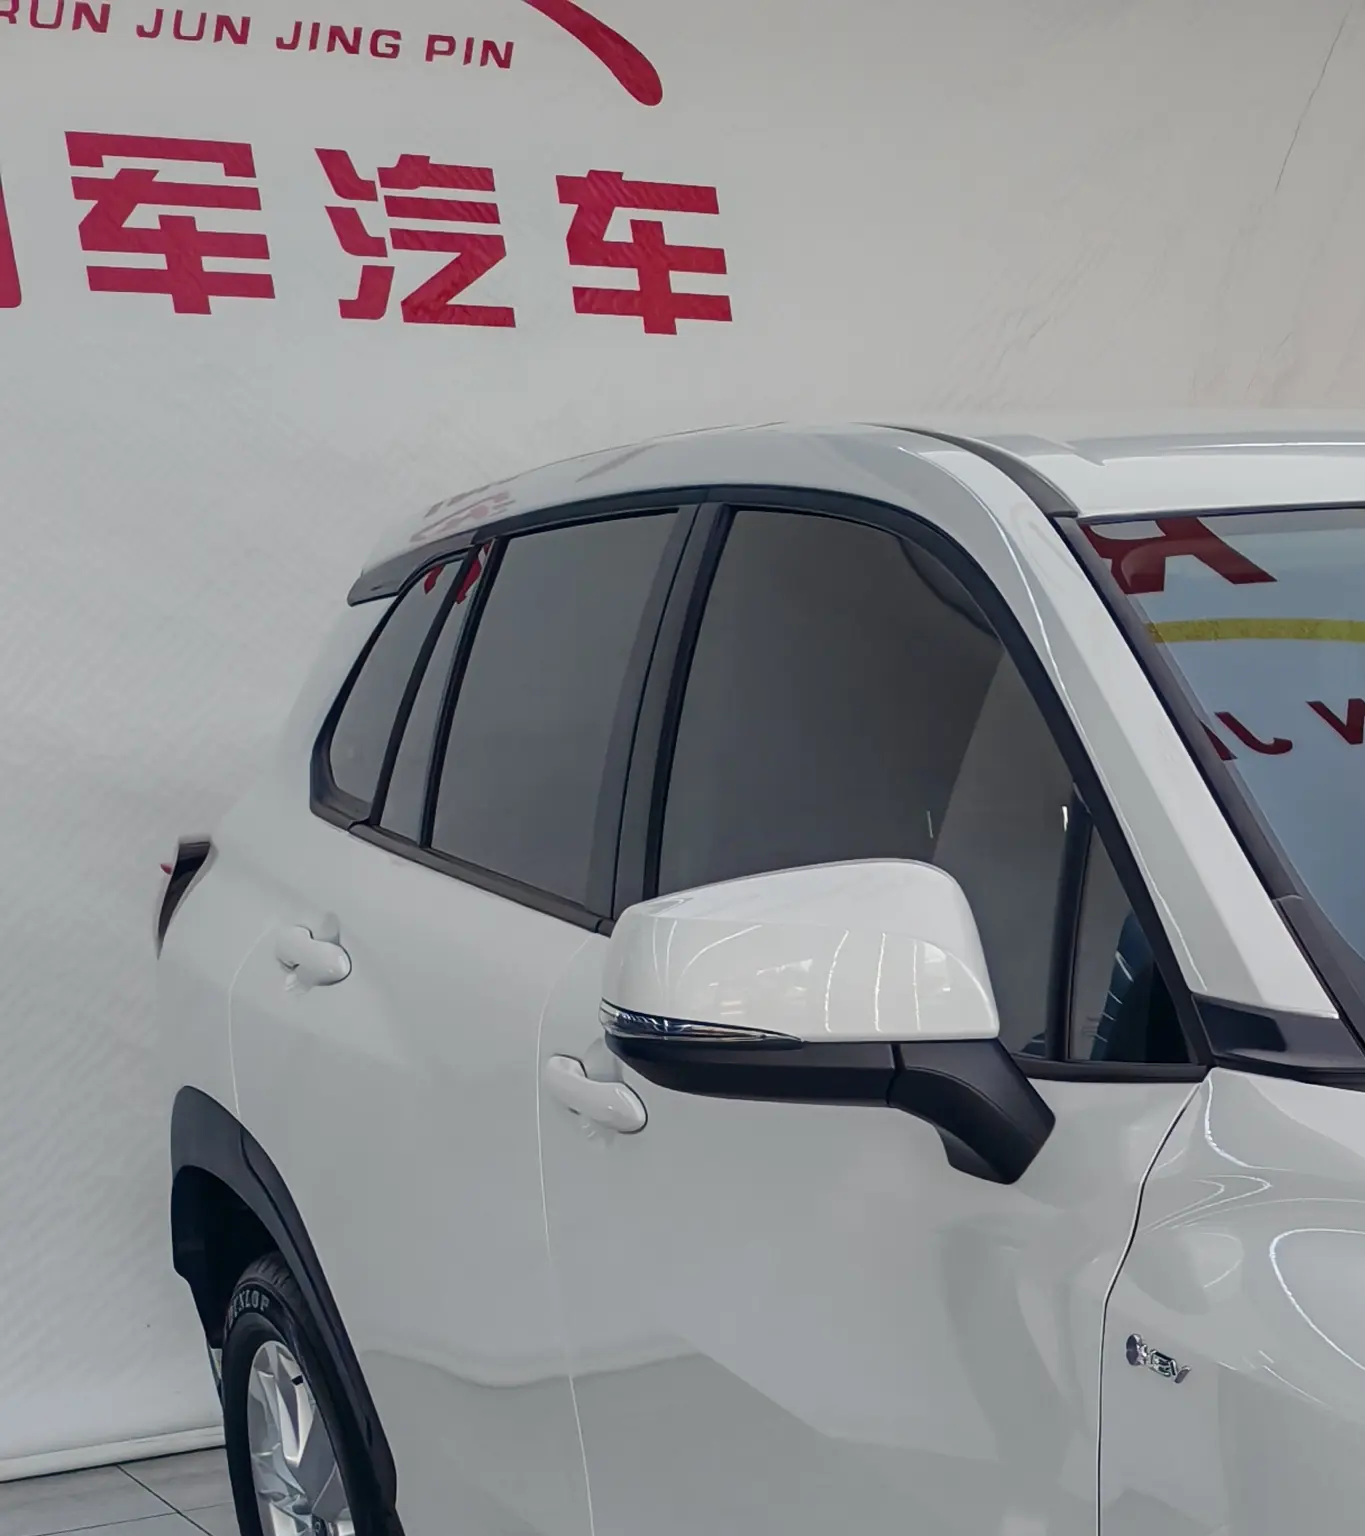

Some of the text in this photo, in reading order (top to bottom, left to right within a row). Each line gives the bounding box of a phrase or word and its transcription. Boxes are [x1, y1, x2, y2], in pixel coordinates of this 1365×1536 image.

[136, 9, 250, 45] JUN
[276, 21, 401, 59] JING
[425, 34, 513, 69] PIN
[0, 131, 732, 335] 军汽车
